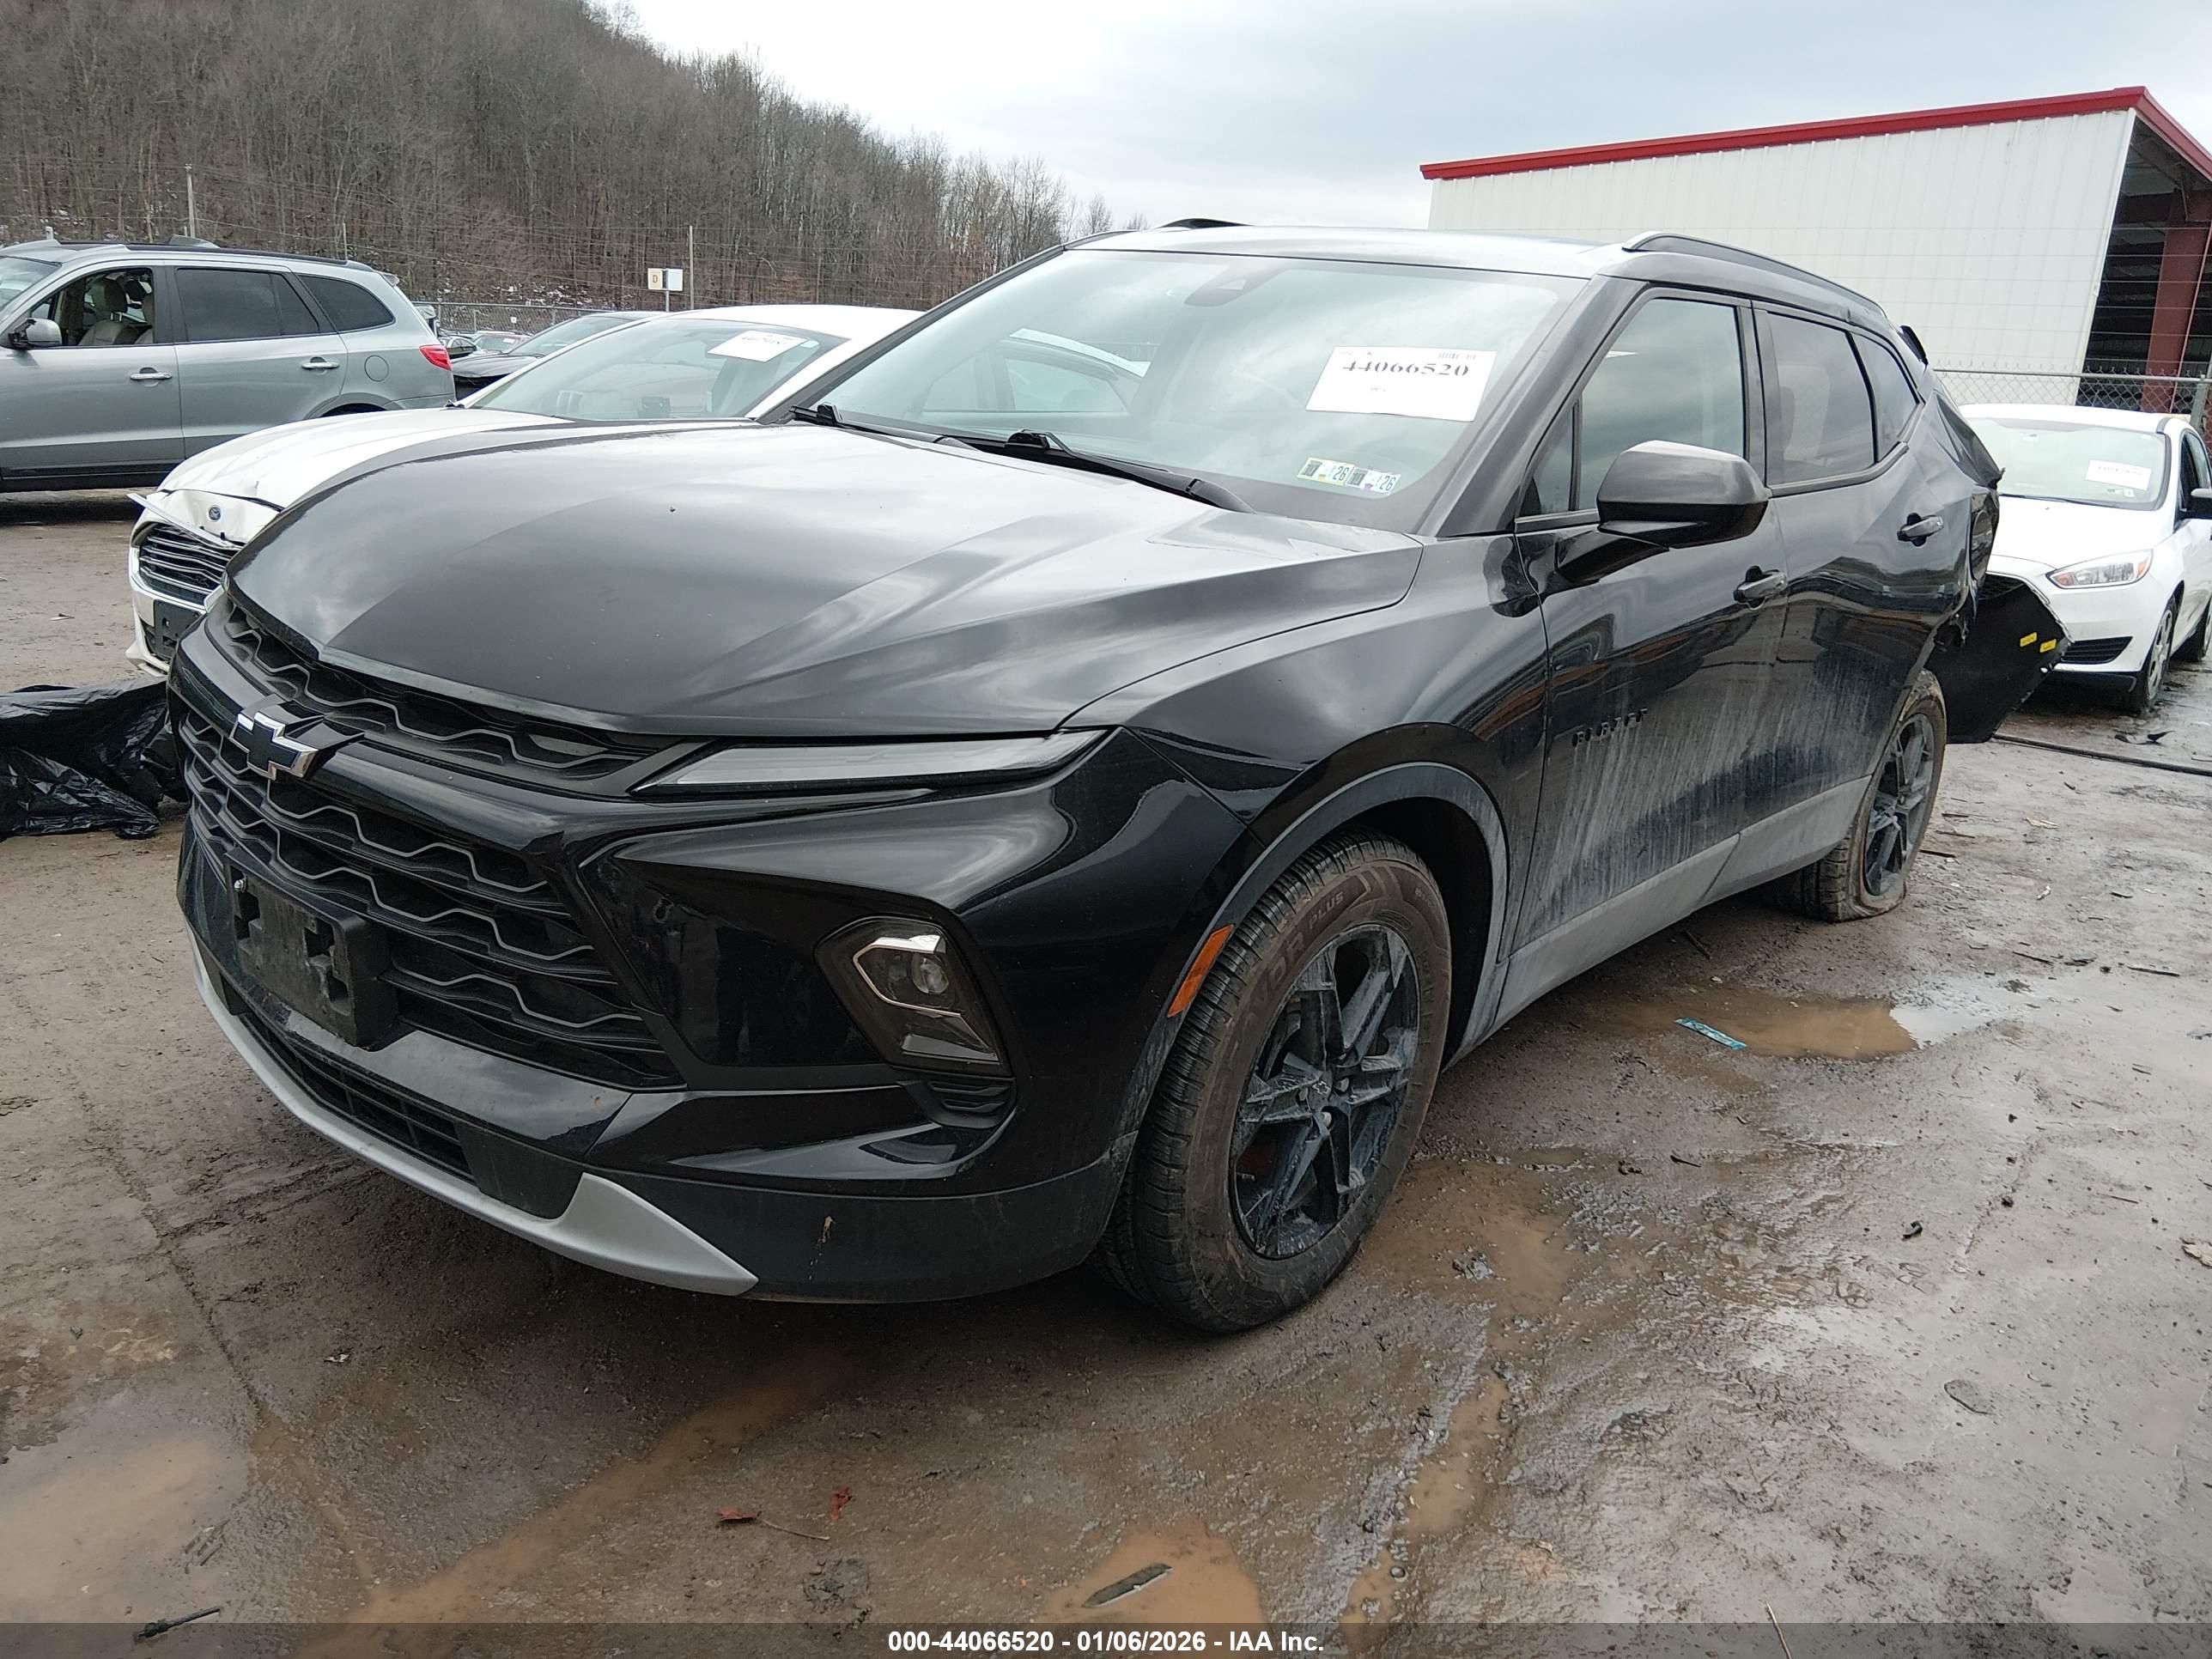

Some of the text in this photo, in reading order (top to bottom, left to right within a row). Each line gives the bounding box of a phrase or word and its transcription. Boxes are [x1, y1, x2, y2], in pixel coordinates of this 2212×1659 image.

[653, 275, 659, 283] D
[1341, 361, 1470, 377] 44066520
[1332, 465, 1350, 481] 26
[1379, 475, 1396, 491] 26
